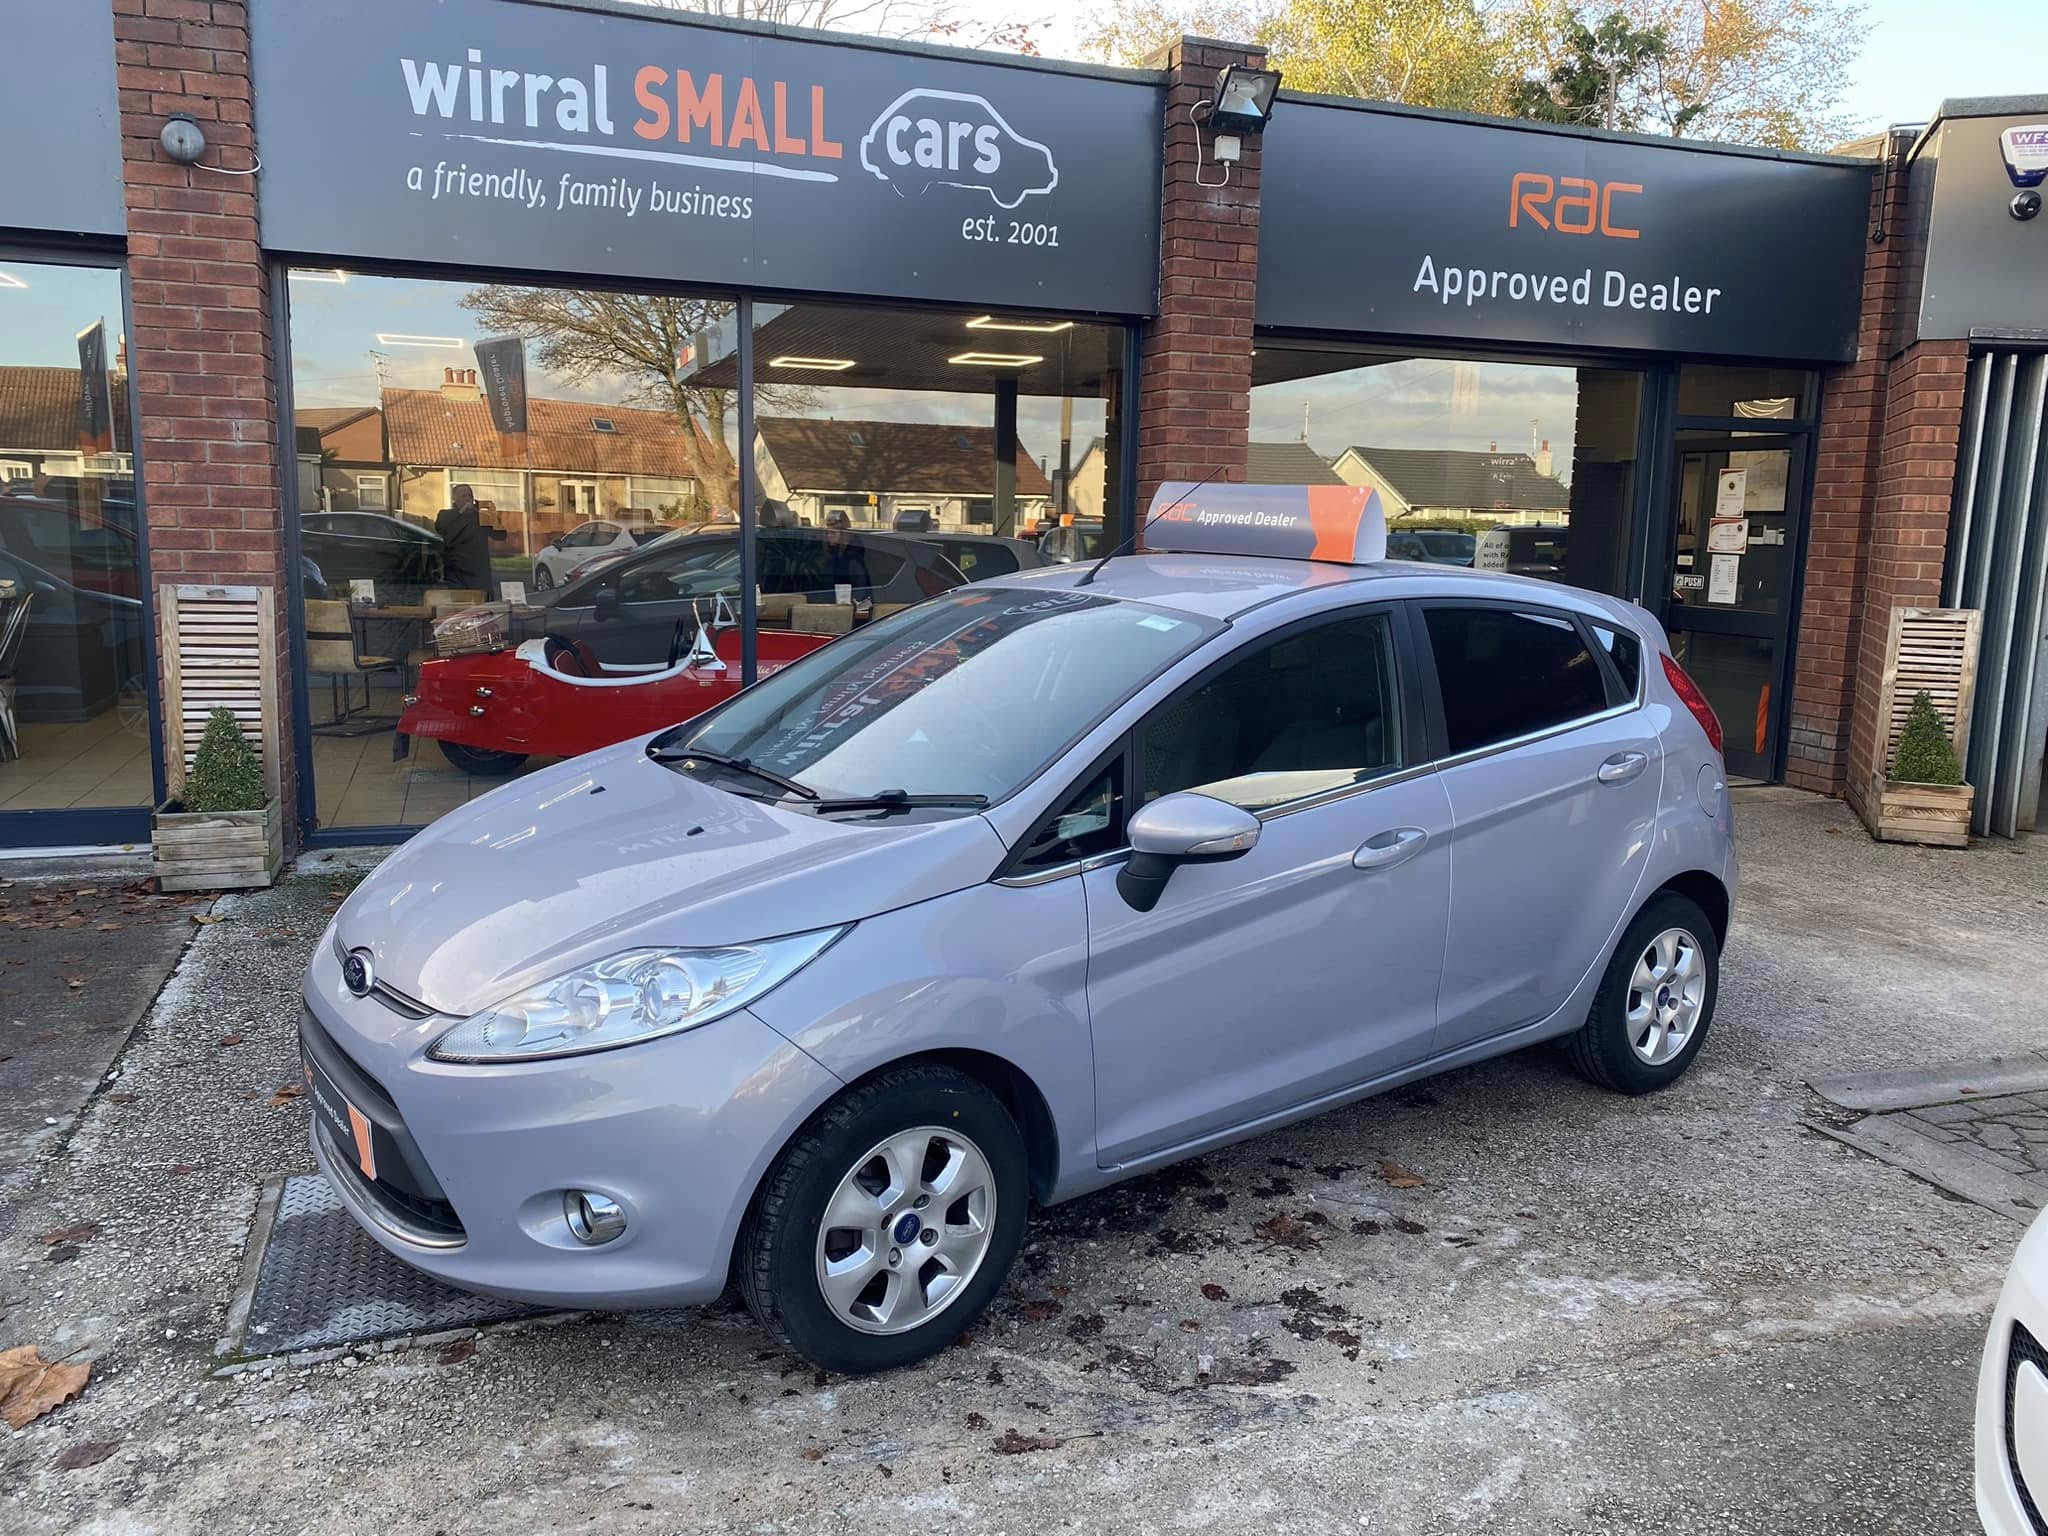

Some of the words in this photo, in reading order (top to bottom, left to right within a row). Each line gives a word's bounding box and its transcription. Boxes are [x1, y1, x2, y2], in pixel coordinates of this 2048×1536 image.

[400, 48, 614, 135] wirral
[633, 65, 842, 158] SMALL
[886, 115, 1000, 174] cars
[406, 166, 423, 190] a
[432, 161, 546, 208] friendly,
[557, 173, 642, 217] family
[650, 181, 753, 219] business
[962, 214, 1000, 242] est.
[1007, 222, 1059, 247] 2001
[1413, 255, 1592, 306] Approved
[1603, 270, 1721, 314] Dealer
[1197, 510, 1252, 527] Approved
[1255, 511, 1297, 527] Dealer
[1684, 575, 1703, 587] PUSH
